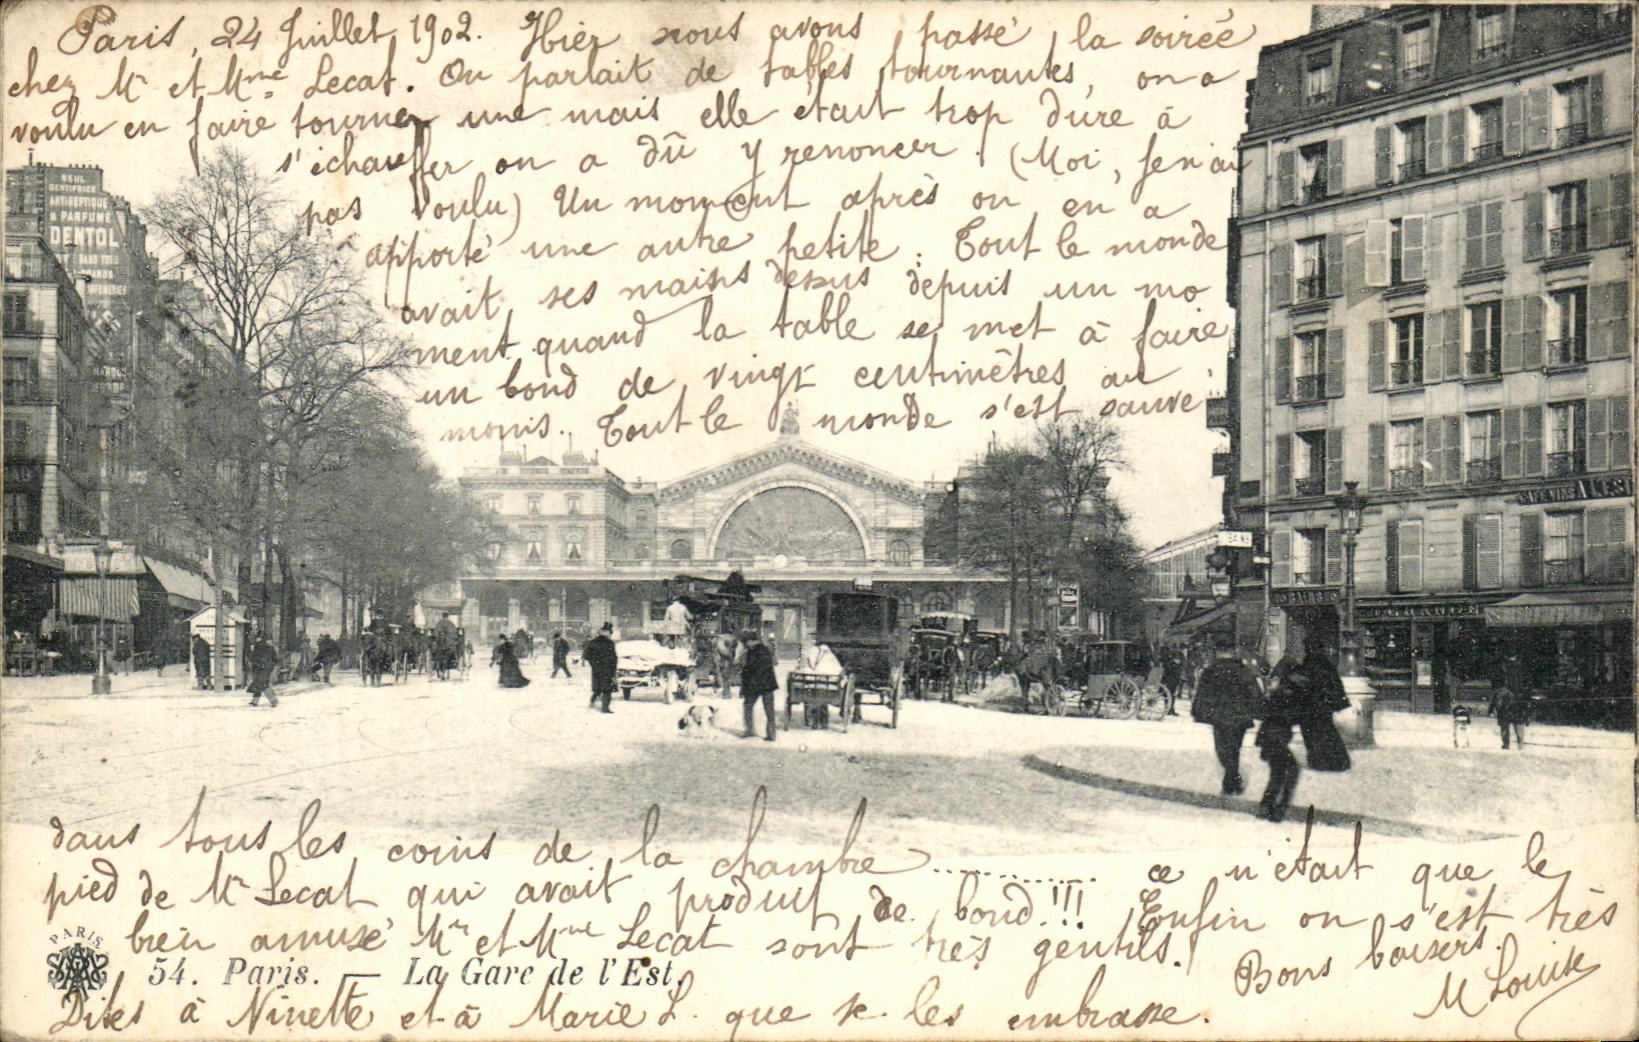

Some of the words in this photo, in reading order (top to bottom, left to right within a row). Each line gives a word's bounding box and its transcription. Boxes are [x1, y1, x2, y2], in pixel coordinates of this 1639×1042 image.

[8, 46, 76, 99] chez
[169, 57, 206, 98] et
[439, 58, 493, 87] On
[507, 49, 654, 107] parlait
[685, 56, 732, 87] de
[759, 39, 853, 87] tables
[1137, 71, 1197, 90] on
[1200, 69, 1240, 88] a
[211, 15, 262, 50] 24
[279, 6, 397, 68] Juillet
[520, 6, 620, 61] Hier
[651, 11, 745, 45] nous
[770, 11, 863, 41] avons
[918, 10, 1032, 78] passé
[1072, 12, 1121, 51] la
[1136, 8, 1257, 50] soirée
[11, 96, 118, 144] voulu
[124, 120, 170, 140] en
[187, 96, 276, 176] faire
[291, 101, 439, 138] tourner
[457, 106, 552, 129] une
[561, 96, 659, 126] mais
[701, 88, 779, 128] elle
[925, 86, 1013, 166] trop
[1158, 106, 1192, 129] à
[496, 157, 556, 174] on
[579, 153, 608, 173] a
[638, 131, 696, 168] dû
[734, 139, 766, 205] y
[50, 226, 120, 247] DENTOL
[297, 196, 361, 236] pas
[554, 184, 613, 217] Un
[625, 167, 810, 212] moment
[841, 172, 938, 246] après
[972, 191, 1020, 209] on
[1063, 198, 1115, 217] en
[1144, 203, 1191, 219] a
[366, 219, 493, 306] apporté
[521, 241, 618, 257] une
[638, 205, 754, 262] autre
[956, 212, 1040, 261] Tout
[1057, 220, 1090, 259] le
[1105, 219, 1228, 256] monde
[401, 275, 502, 327] avait
[539, 280, 598, 309] ses
[906, 268, 1011, 326] depuis
[1044, 281, 1117, 299] un
[412, 309, 520, 366] ment
[536, 303, 690, 377] quand
[693, 296, 747, 342] la
[771, 284, 876, 340] table
[897, 320, 942, 339] se
[963, 301, 1056, 341] met
[1079, 321, 1111, 345] à
[1132, 298, 1229, 376] faire
[415, 385, 483, 406] un
[497, 358, 578, 400] bond
[618, 366, 676, 401] de
[703, 353, 816, 431] vingt
[1101, 368, 1182, 389] au
[597, 385, 692, 447] Tout
[700, 394, 742, 434] le
[812, 392, 952, 434] monde
[980, 385, 1083, 422] s'est
[50, 816, 140, 852] dans
[158, 785, 272, 853] tous
[279, 798, 346, 859] les
[387, 832, 496, 865] coins
[533, 829, 593, 865] de
[620, 804, 682, 868] la
[711, 785, 931, 879] chambre
[1148, 864, 1185, 884] ce
[1412, 863, 1494, 912] que
[1522, 830, 1570, 879] le
[43, 857, 118, 924] pied
[139, 869, 176, 909] de
[408, 881, 486, 936] qui
[514, 858, 632, 904] avait
[668, 868, 839, 932] produit
[1137, 877, 1265, 975] Enfin
[1300, 911, 1368, 928] on
[1526, 872, 1618, 932] très
[125, 909, 216, 953] bien
[251, 917, 393, 953] amusé
[476, 908, 517, 957] et
[767, 915, 893, 961] sont
[912, 909, 992, 963] très
[1235, 948, 1331, 997] Bons
[49, 971, 144, 1034] Dites
[180, 997, 206, 1023] à
[400, 972, 449, 1029] et
[455, 1004, 482, 1029] à
[509, 976, 647, 1031] Marie
[725, 1005, 811, 1042] que
[903, 975, 963, 1027] les
